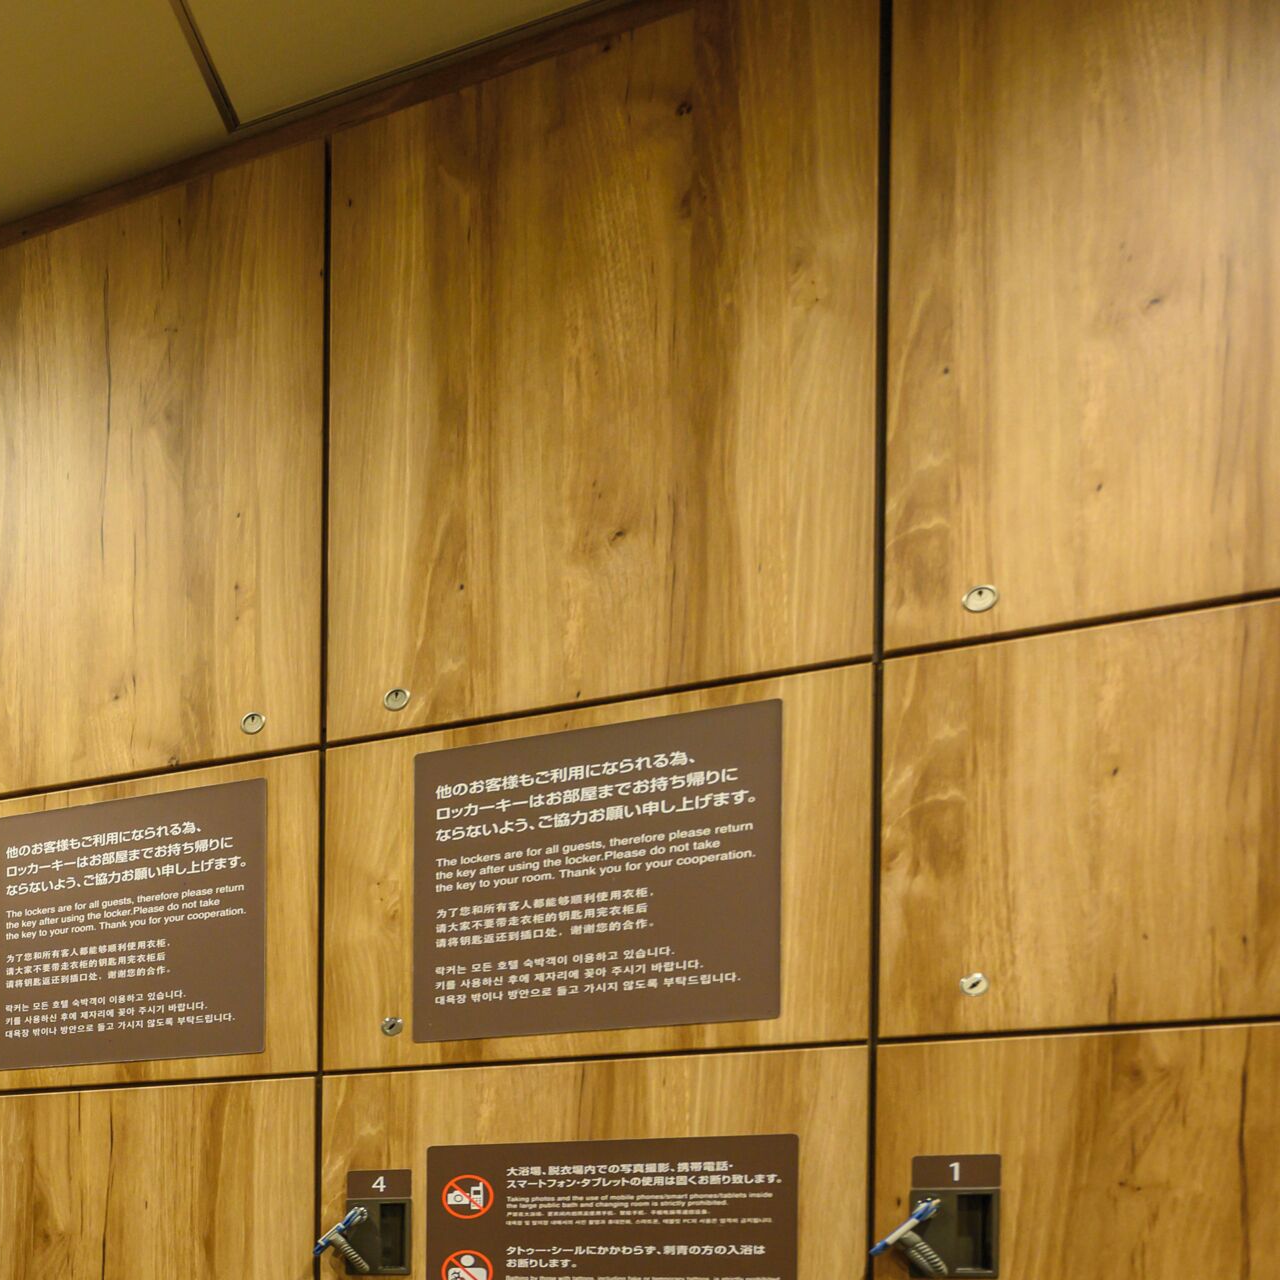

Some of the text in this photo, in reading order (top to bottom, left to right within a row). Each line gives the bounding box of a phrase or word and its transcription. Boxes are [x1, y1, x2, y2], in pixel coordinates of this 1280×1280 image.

[435, 750, 695, 800] 他のお客様もご利用になられる為、
[436, 767, 738, 820] ロッカーキーはお部屋までお持ち帰りに
[435, 789, 756, 842] ならないよう、ご協力お願い申し上げます。
[5, 820, 201, 859] 他のお客様もご利用になられる為、
[6, 836, 233, 877] ロッカーキーはお部屋までお持ち帰りに
[435, 822, 754, 867] The lockers are for all guests, therefore please return
[435, 839, 720, 880] the key after using the locker.Please do not take
[6, 855, 246, 896] ならないよう、ご協力お願い申し上げます。
[435, 849, 756, 893] the key to your room. Thank you for your cooperation.
[371, 1175, 387, 1193] 4
[948, 1161, 960, 1182] 1
